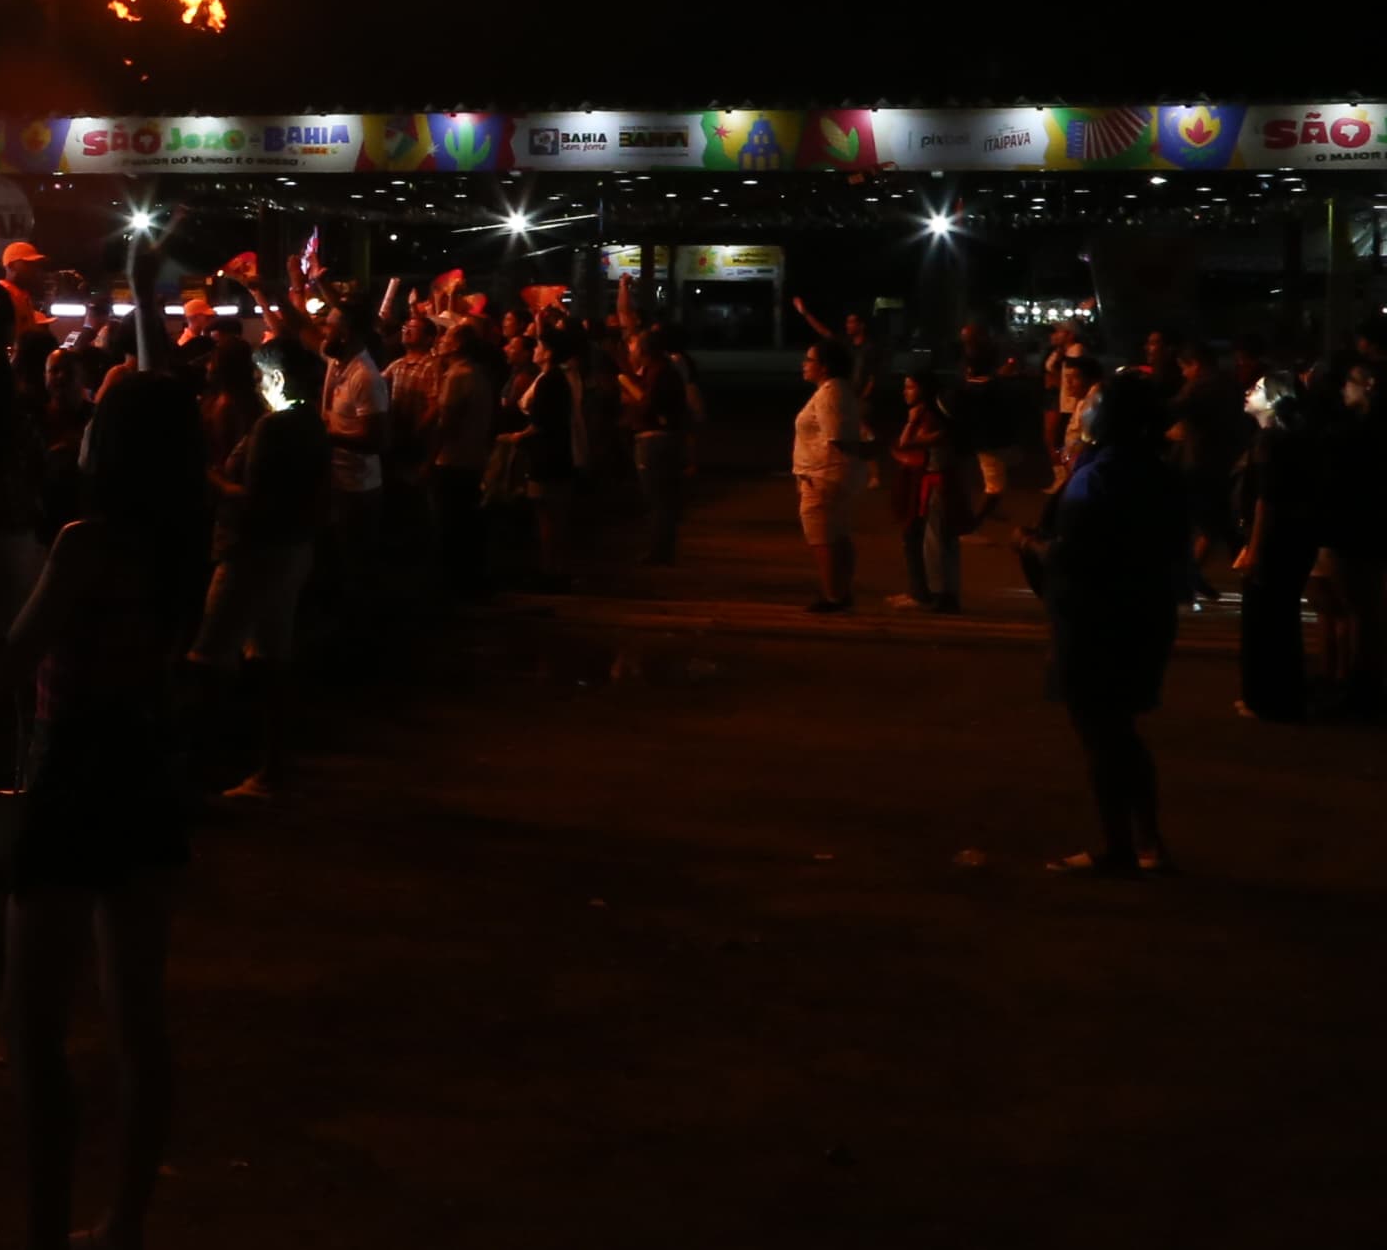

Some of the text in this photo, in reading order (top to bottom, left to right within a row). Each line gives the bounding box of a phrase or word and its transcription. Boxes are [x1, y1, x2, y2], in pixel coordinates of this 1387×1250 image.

[83, 124, 161, 156] SÃO
[264, 125, 350, 152] BAHIA
[561, 132, 607, 143] BAHIA
[1263, 112, 1372, 149] SÃO
[984, 132, 1031, 151] ITAIPAVA
[1330, 151, 1381, 162] MAIOR
